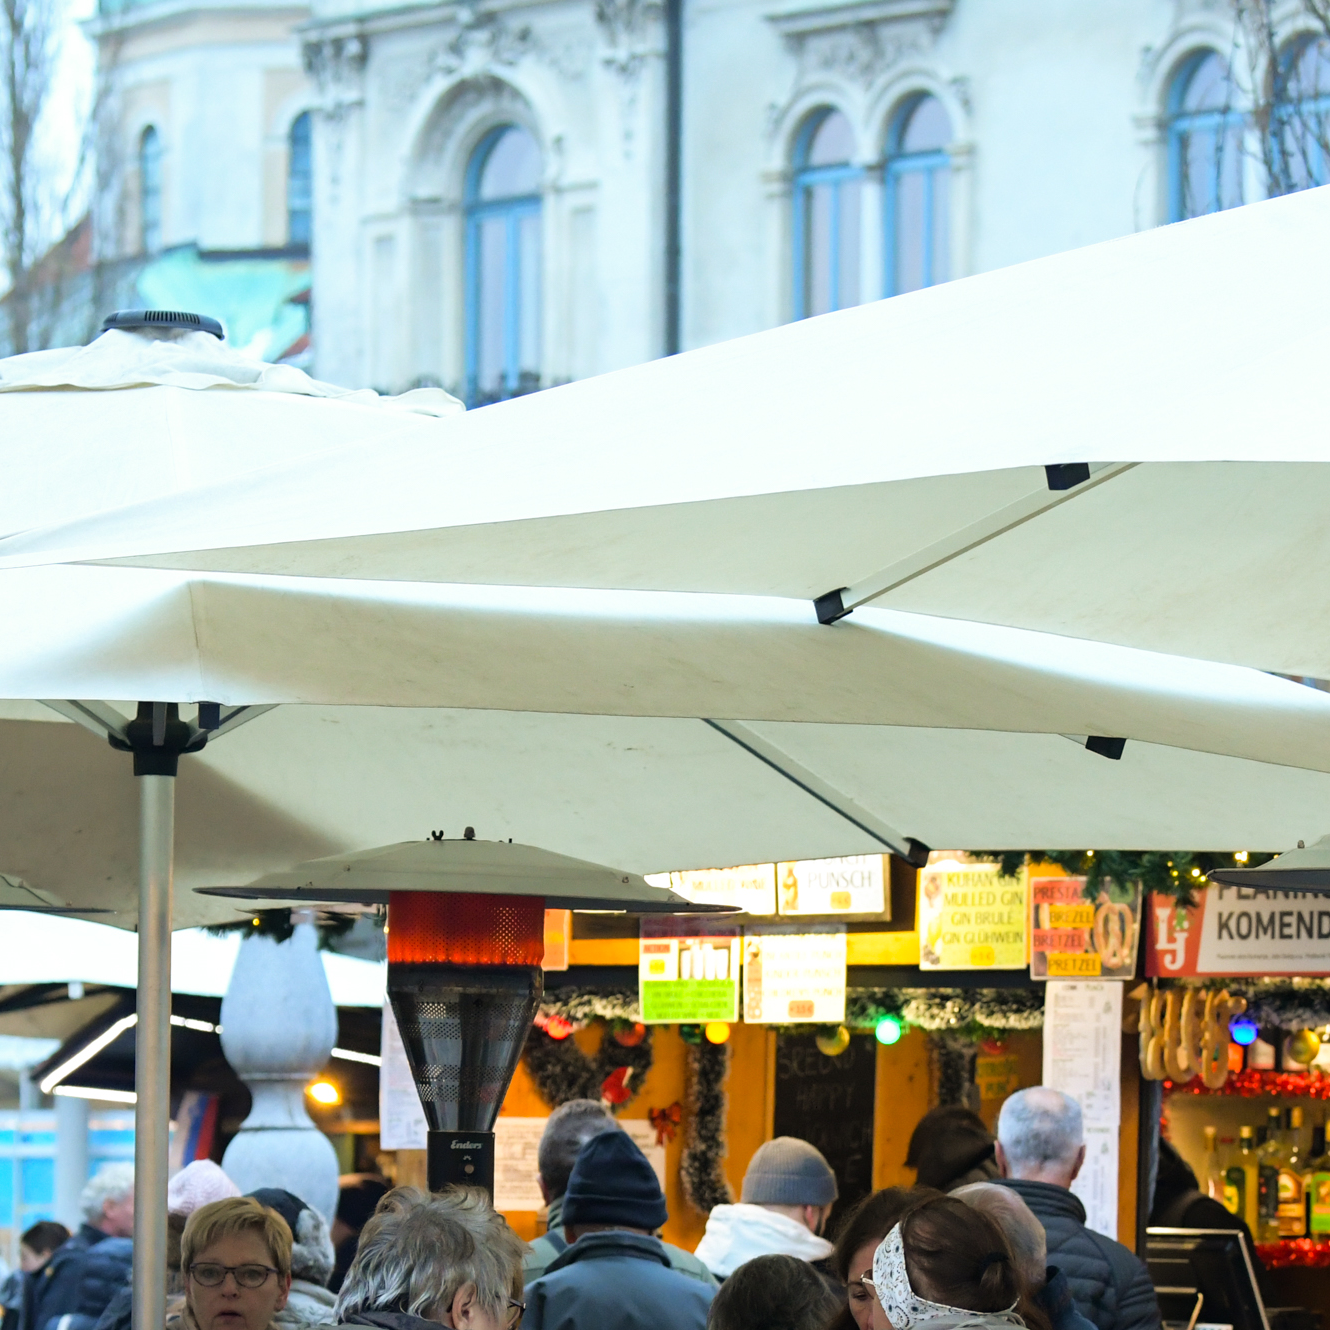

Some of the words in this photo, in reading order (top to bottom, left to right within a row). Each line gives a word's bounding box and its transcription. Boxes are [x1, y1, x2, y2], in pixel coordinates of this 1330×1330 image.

[808, 870, 872, 889] PUNSCH
[946, 872, 993, 887] KUHAN
[944, 891, 996, 907] MULLED
[1000, 890, 1023, 906] GIN
[1033, 886, 1081, 899] PRESTA
[951, 912, 972, 925] GIN
[974, 907, 1014, 926] BRULÉ
[1049, 911, 1092, 924] BREZEL
[941, 931, 961, 945] GIN
[963, 928, 1024, 945] GLÜHWEIN
[1033, 934, 1084, 948] BRETZEL
[1048, 958, 1100, 972] PRETZEL
[450, 1139, 483, 1150] Enders
